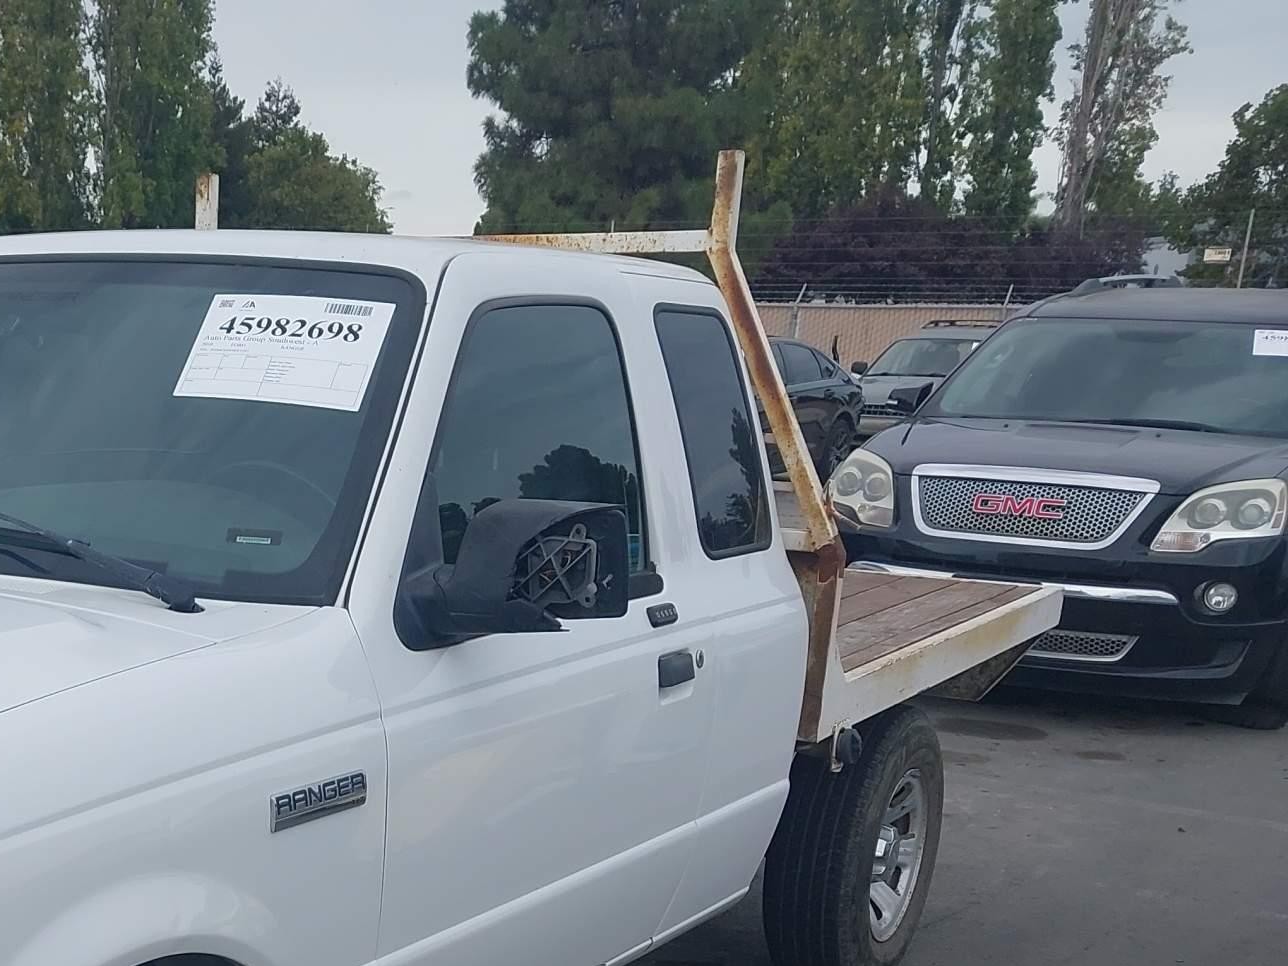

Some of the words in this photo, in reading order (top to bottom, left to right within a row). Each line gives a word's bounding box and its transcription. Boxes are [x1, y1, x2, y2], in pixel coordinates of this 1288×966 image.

[204, 334, 222, 342] Auto
[223, 335, 242, 343] Parts
[243, 336, 265, 344] Group
[267, 337, 305, 345] Southwest
[219, 316, 364, 343] 45982698
[973, 494, 1066, 519] GMC
[275, 773, 365, 815] RANGER
